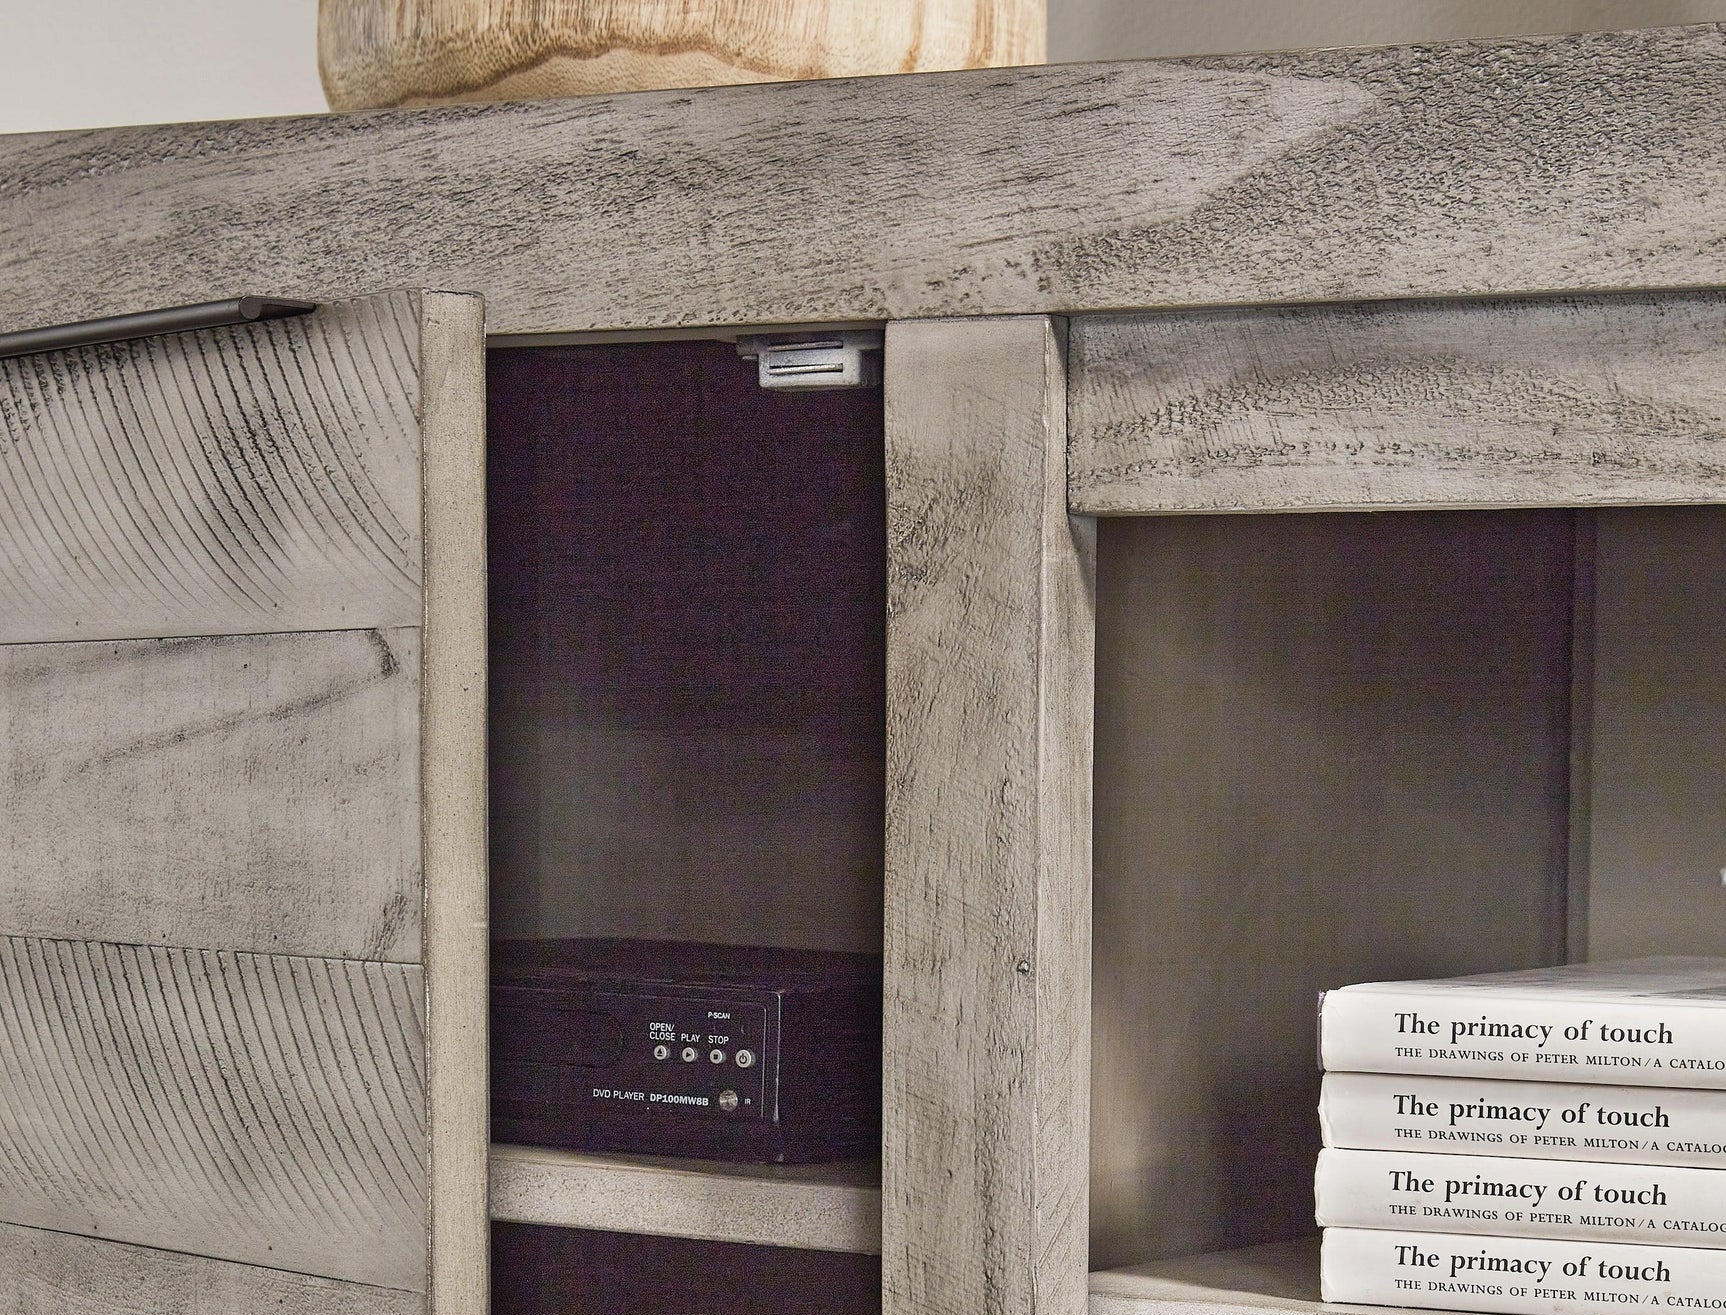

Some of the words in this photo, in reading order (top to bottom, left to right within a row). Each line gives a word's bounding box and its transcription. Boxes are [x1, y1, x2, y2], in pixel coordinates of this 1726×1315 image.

[649, 1022, 675, 1032] OPEN/
[1395, 1013, 1440, 1034] The
[1450, 1016, 1553, 1048] primacy
[1564, 1020, 1593, 1040] of
[1600, 1023, 1673, 1044] touch
[649, 1032, 676, 1042] CLOSE
[680, 1032, 701, 1043] PLAY
[707, 1034, 730, 1045] STOP
[1395, 1047, 1422, 1057] THE
[1429, 1049, 1503, 1061] DRAWINGS
[1511, 1053, 1528, 1062] OF
[1536, 1054, 1578, 1064] PETER
[592, 1088, 611, 1099] DVD
[613, 1090, 645, 1101] PLAYER
[1393, 1095, 1438, 1116] The
[1449, 1098, 1551, 1130] primacy
[1562, 1103, 1590, 1123] of
[1597, 1106, 1670, 1127] touch
[1395, 1129, 1421, 1138] THE
[1429, 1130, 1502, 1142] DRAWINGS
[1510, 1134, 1527, 1143] OF
[1534, 1136, 1576, 1146] PETER
[1389, 1171, 1434, 1192] The
[1444, 1175, 1547, 1207] primacy
[1558, 1180, 1587, 1200] of
[1594, 1184, 1667, 1205] touch
[1389, 1205, 1416, 1215] THE
[1423, 1207, 1498, 1220] DRAWINGS
[1505, 1212, 1523, 1221] OF
[1530, 1213, 1572, 1224] PETER
[1395, 1246, 1439, 1267] The
[1449, 1250, 1552, 1284] primacy
[1563, 1256, 1592, 1276] of
[1598, 1261, 1670, 1282] touch
[1395, 1279, 1421, 1290] THE
[1428, 1282, 1502, 1295] DRAWINGS
[1510, 1287, 1527, 1296] OF
[1535, 1289, 1576, 1300] PETER
